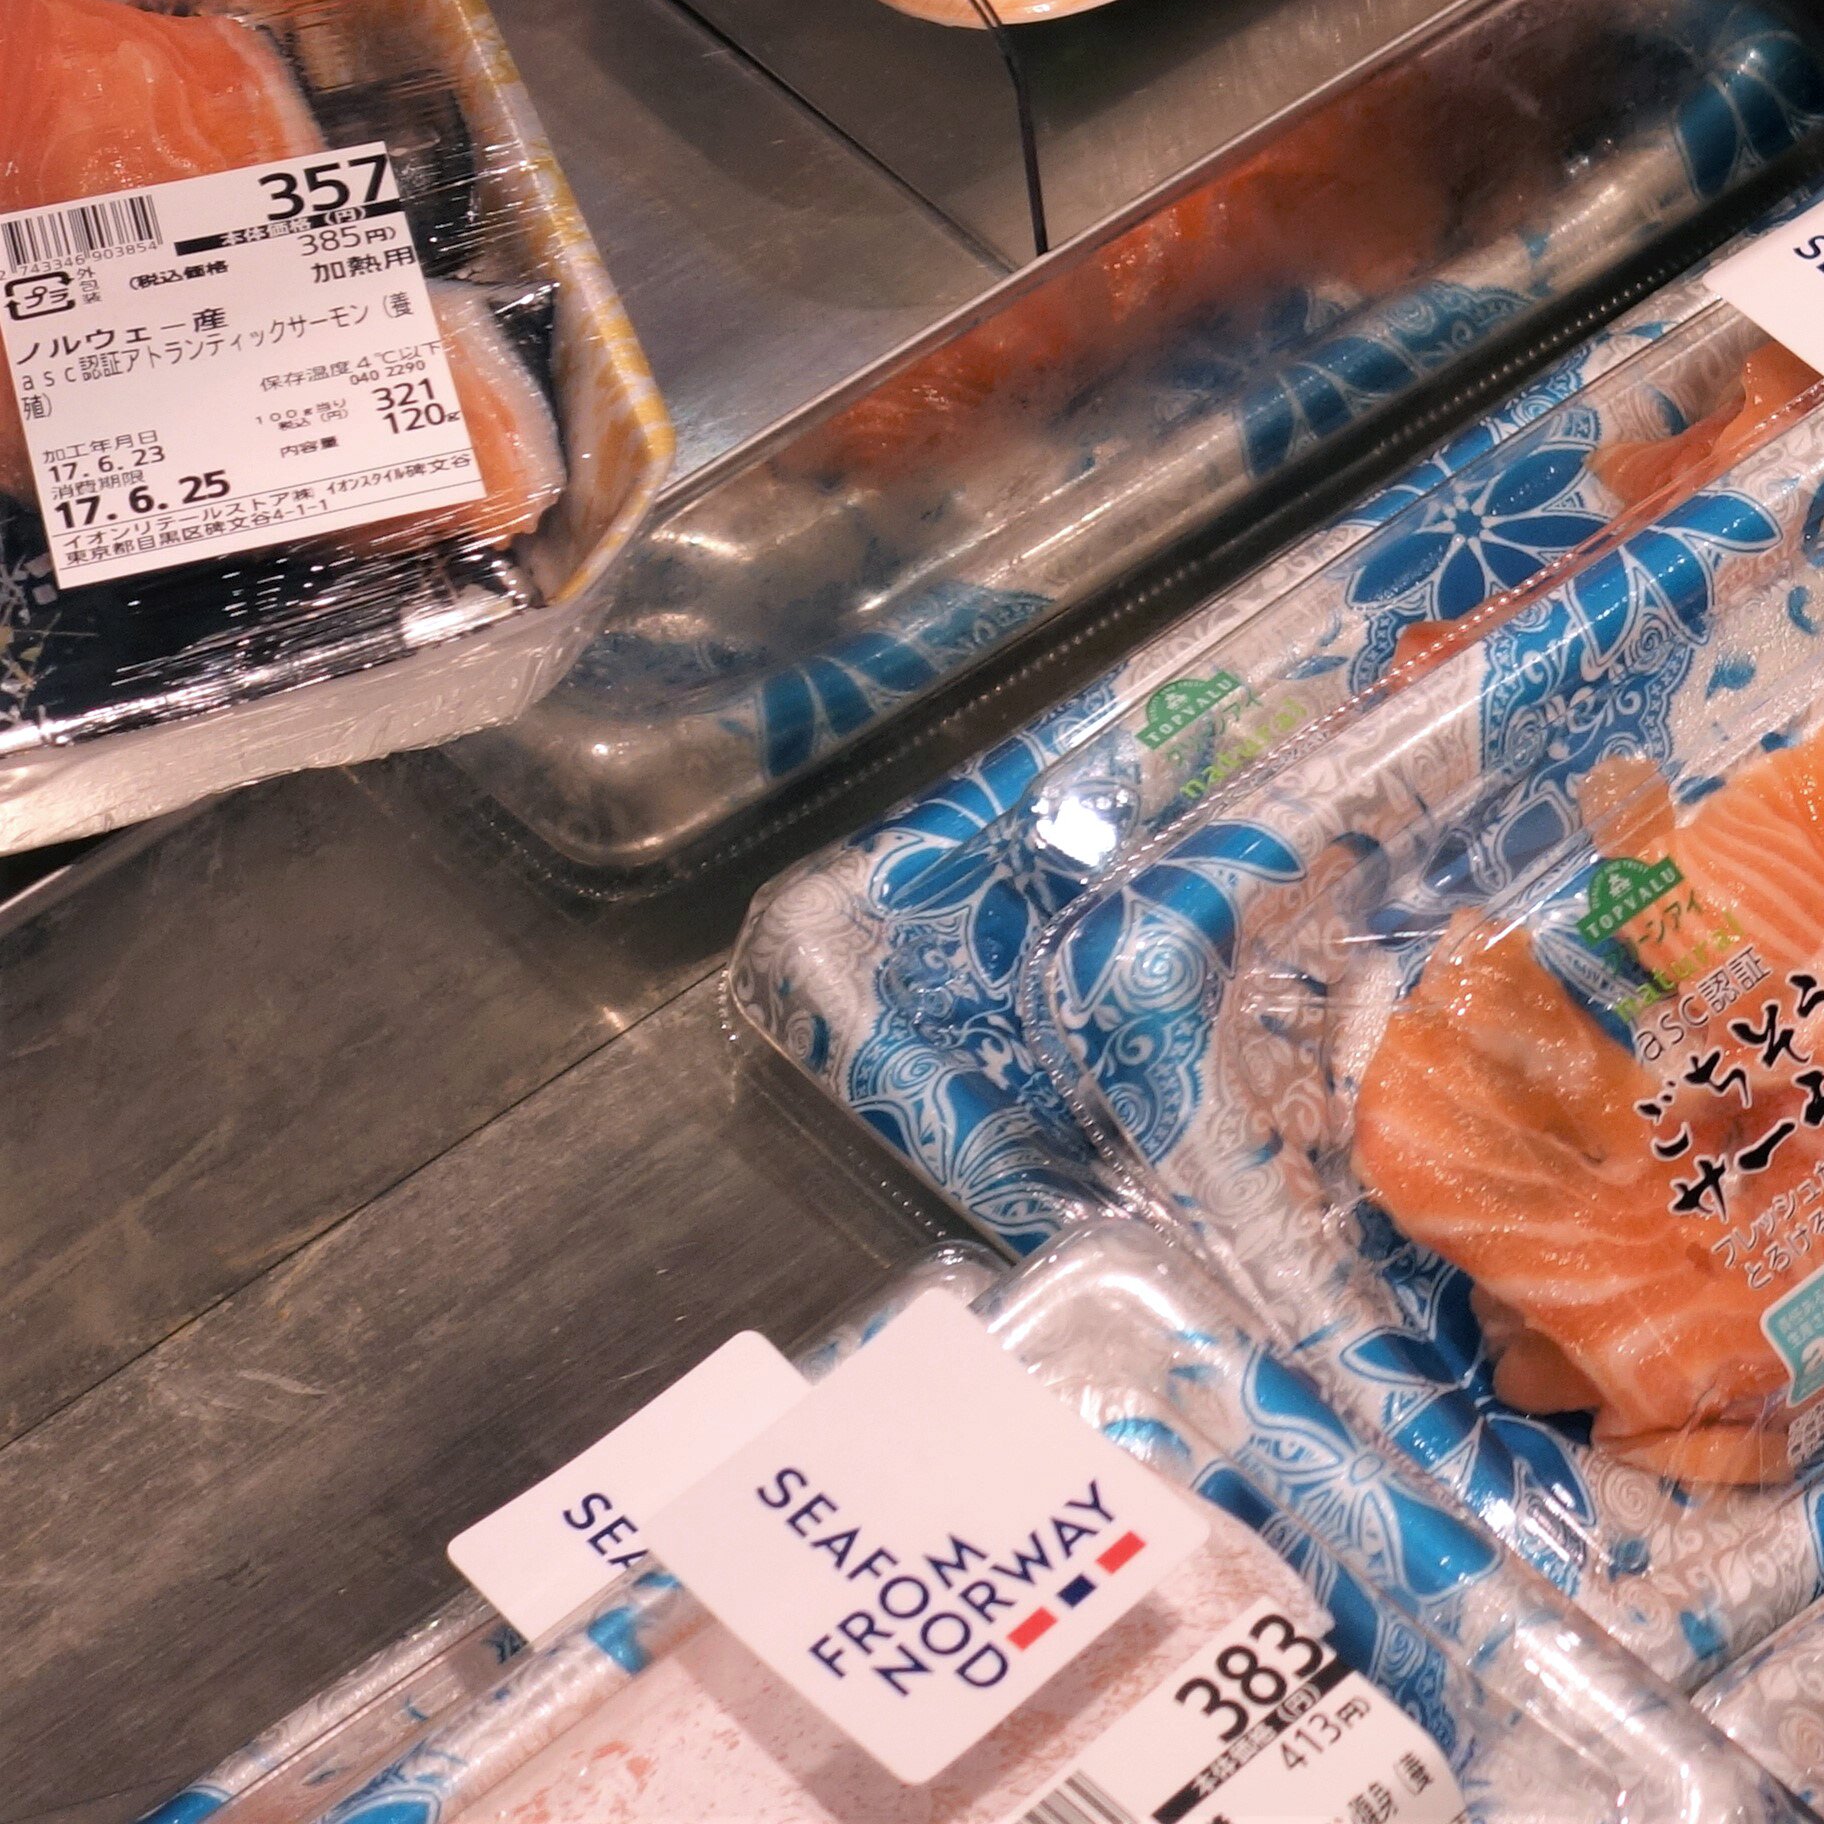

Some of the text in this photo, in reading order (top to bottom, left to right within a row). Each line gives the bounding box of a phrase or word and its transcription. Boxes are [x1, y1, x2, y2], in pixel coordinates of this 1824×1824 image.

[259, 148, 393, 221] 357
[311, 241, 416, 284] 加熱用
[17, 308, 227, 365] ノルウェー産
[372, 378, 434, 411] 321
[43, 430, 157, 464] 加工年月日
[281, 436, 338, 457] 内容量
[53, 463, 145, 500] 消費期限
[809, 1534, 990, 1680] FROM
[867, 1479, 1119, 1698] NORWAY
[1174, 1613, 1324, 1743] 383
